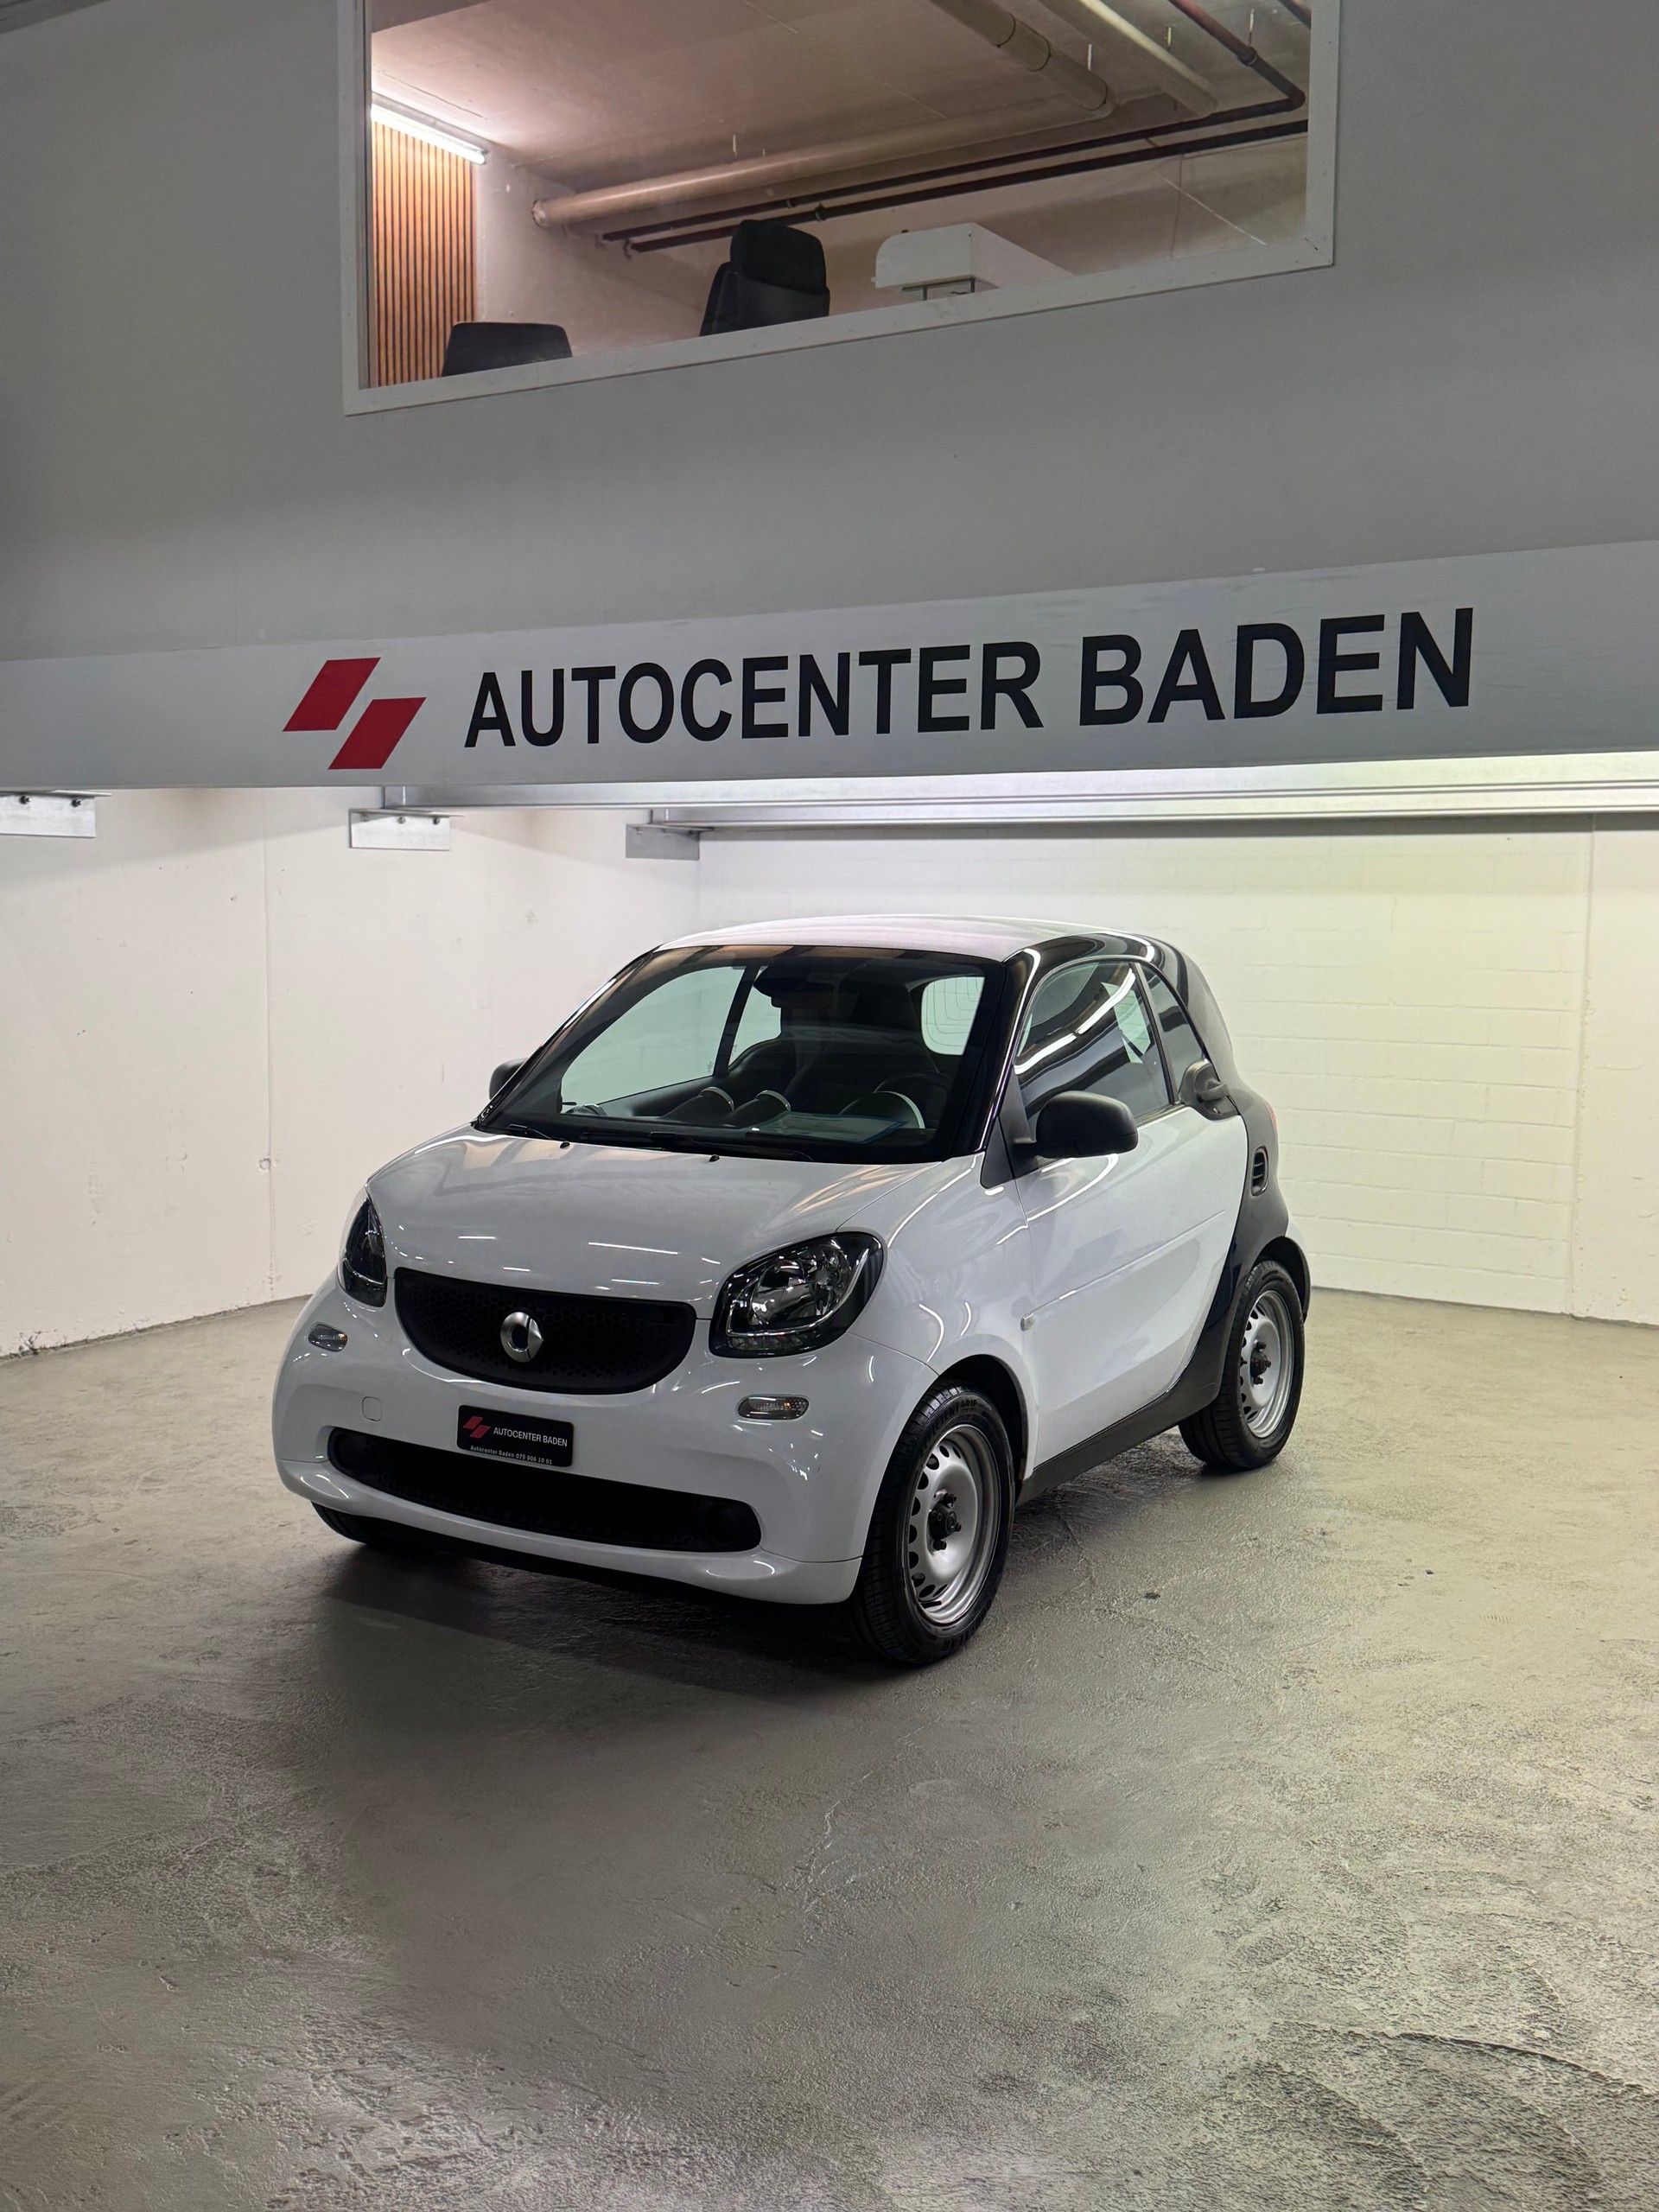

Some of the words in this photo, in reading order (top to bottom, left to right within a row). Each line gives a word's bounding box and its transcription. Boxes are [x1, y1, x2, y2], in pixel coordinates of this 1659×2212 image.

[464, 641, 1045, 748] AUTOCENTER
[1079, 607, 1474, 727] BADEN
[493, 1427, 542, 1442] AUTOCENTER
[543, 1435, 568, 1447] BADEN
[470, 1445, 498, 1455] Autocenter
